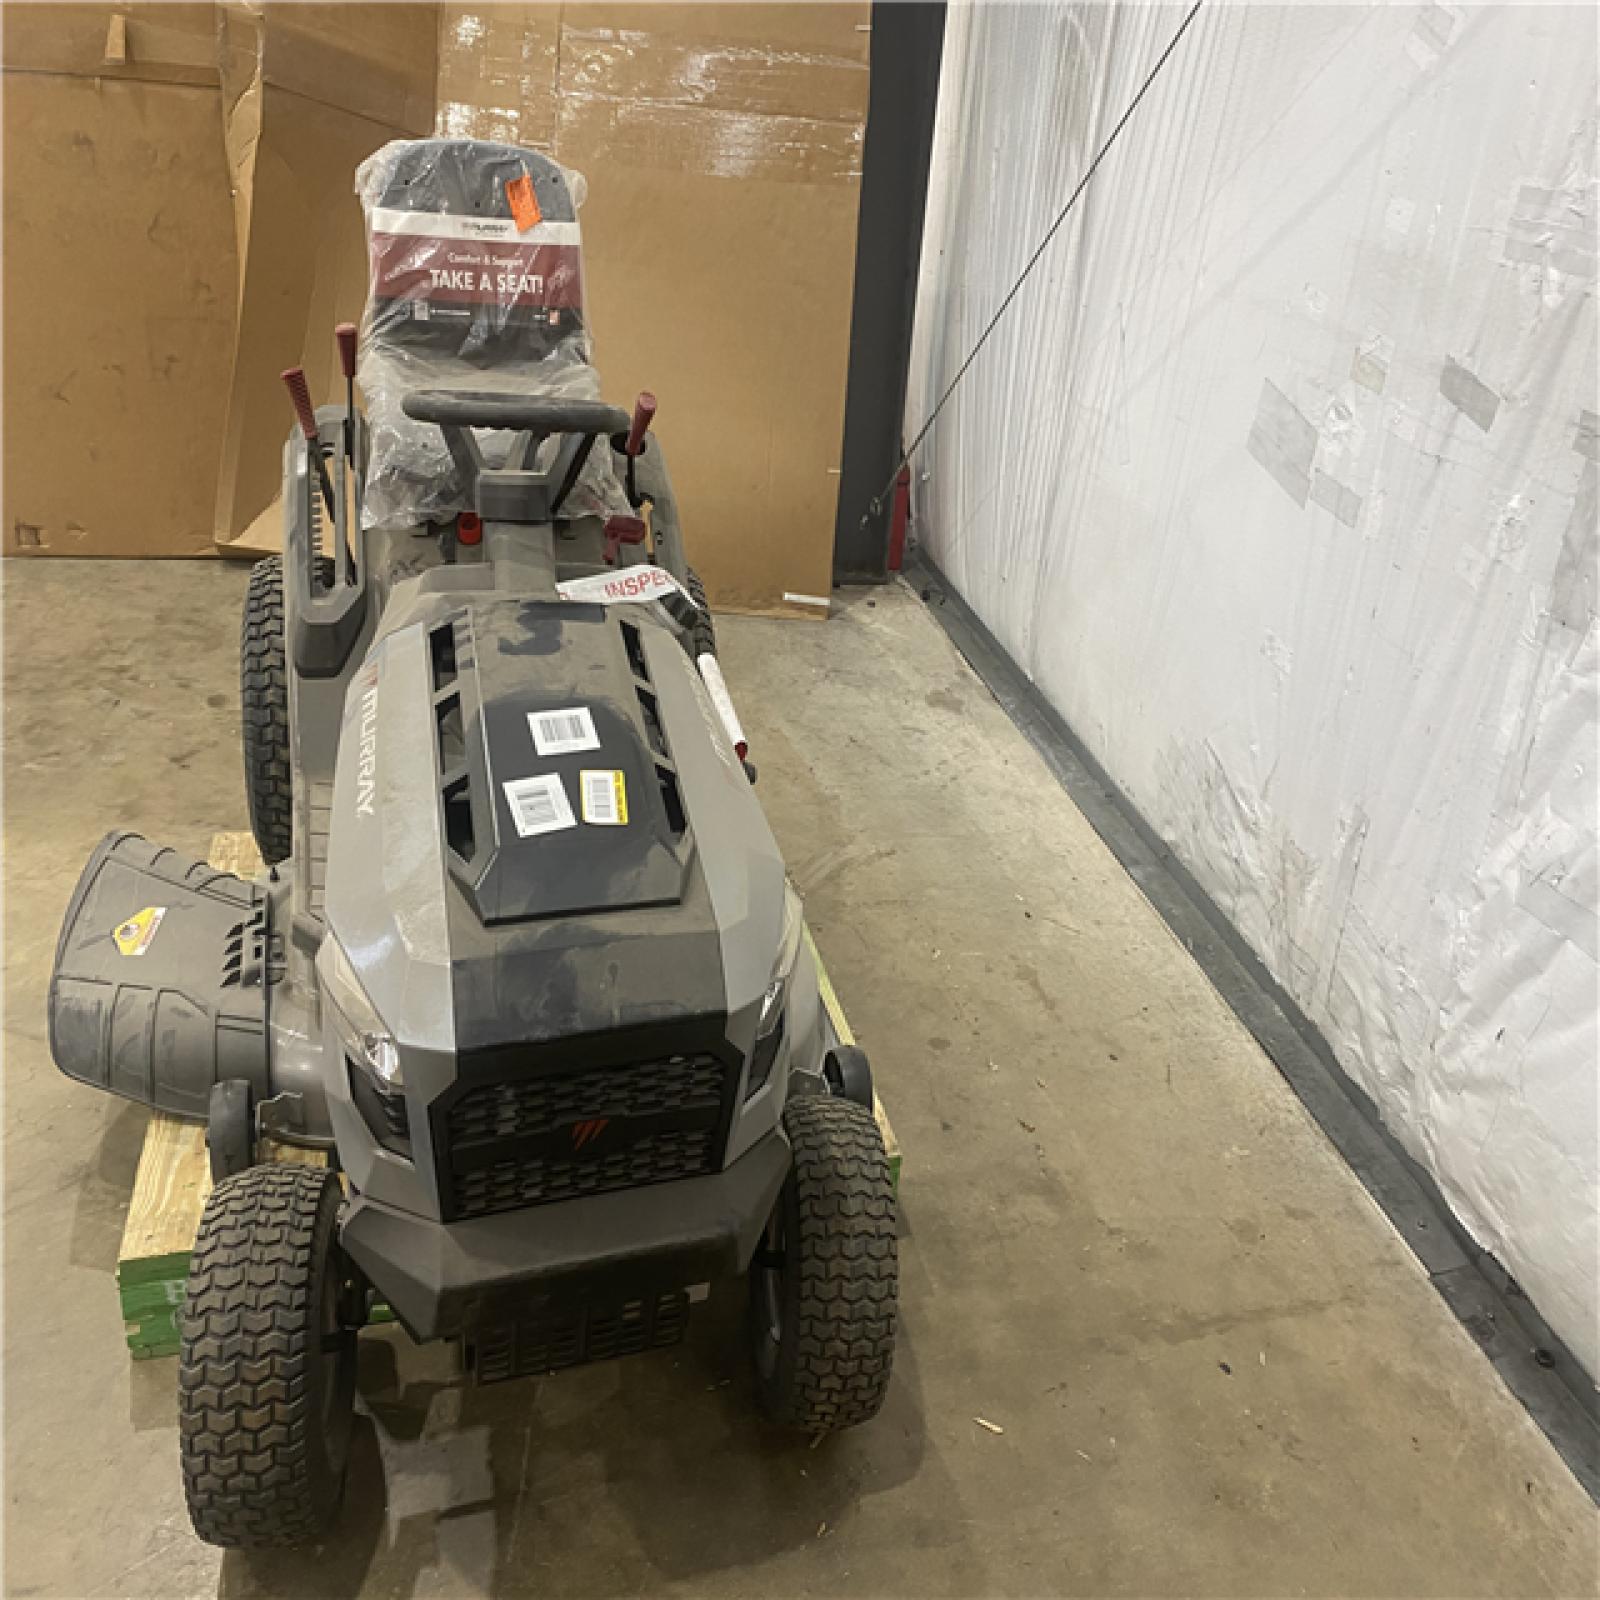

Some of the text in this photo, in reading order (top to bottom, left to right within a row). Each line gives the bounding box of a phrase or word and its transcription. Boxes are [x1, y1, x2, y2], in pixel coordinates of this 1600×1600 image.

[430, 269, 543, 294] TAKE A SEAT!
[356, 687, 379, 818] MURRAY
